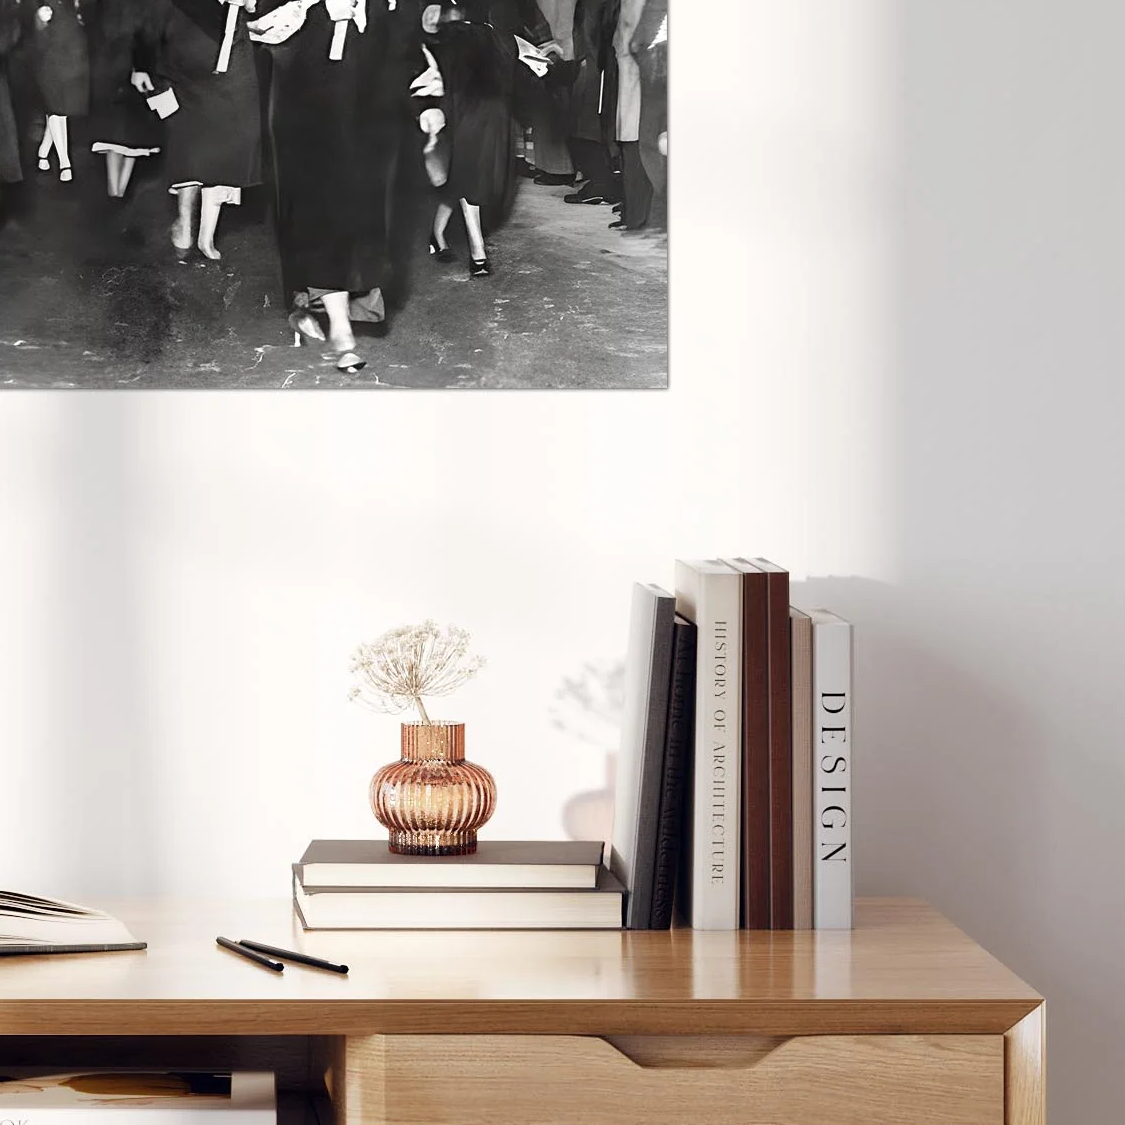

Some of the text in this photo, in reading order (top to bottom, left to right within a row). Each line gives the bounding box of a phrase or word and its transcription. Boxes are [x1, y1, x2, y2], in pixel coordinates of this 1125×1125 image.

[711, 621, 727, 884] HISTORY OF ARCHITECTURE
[821, 692, 847, 862] DESIGN
